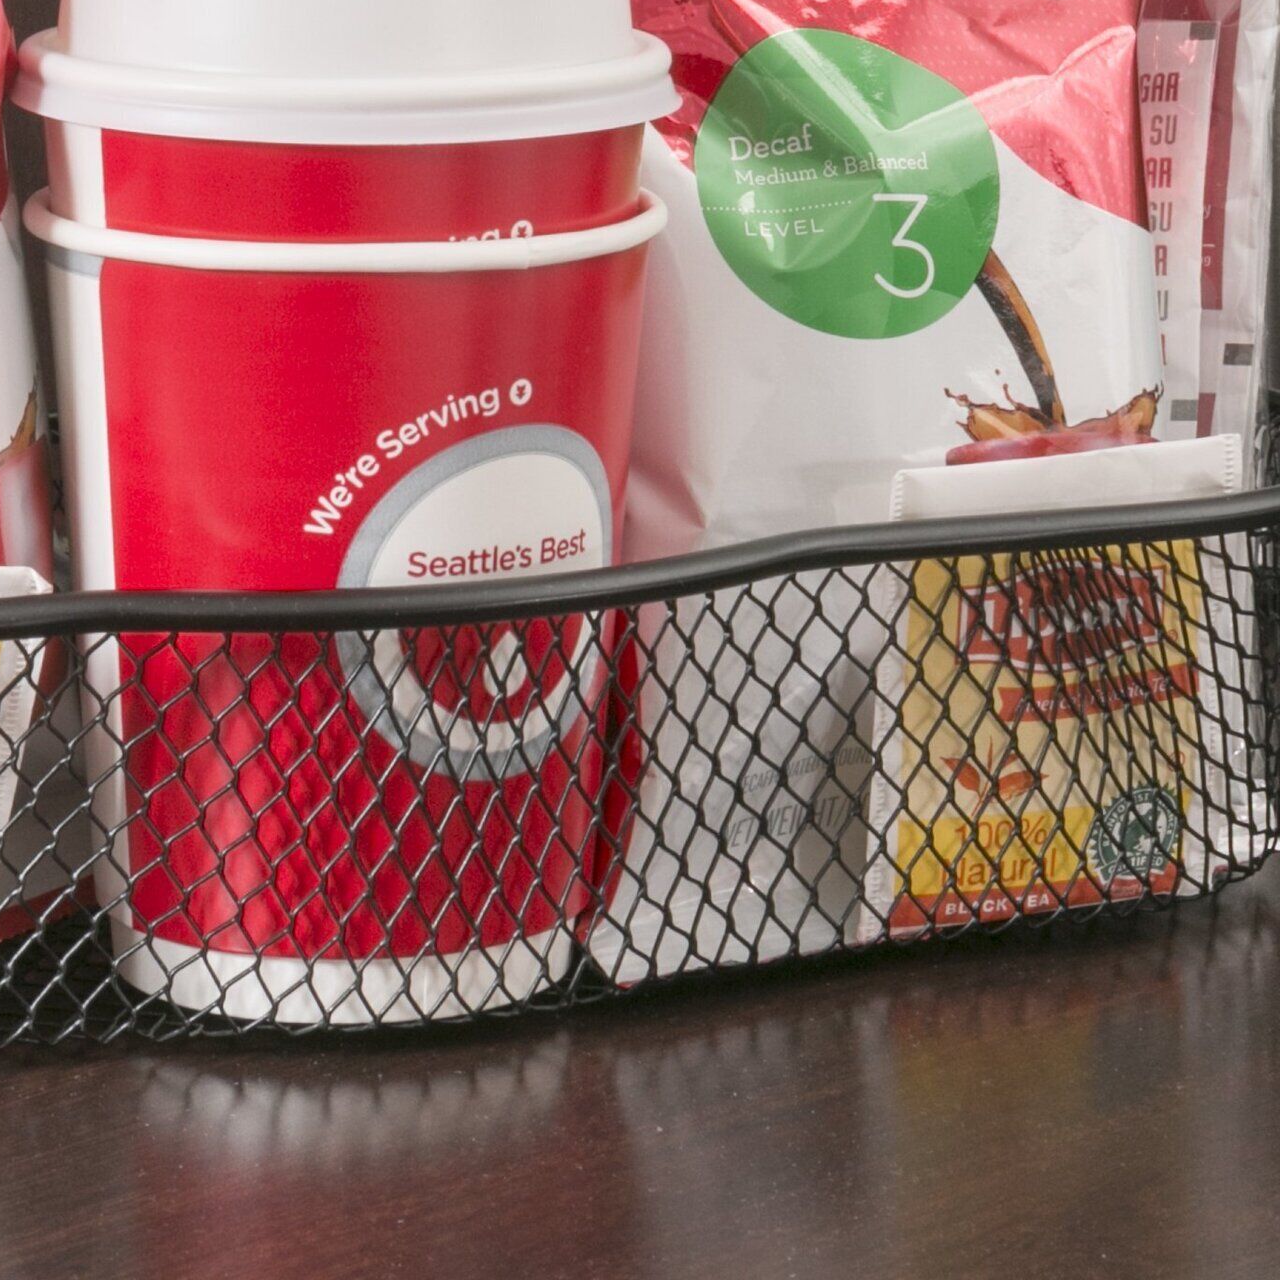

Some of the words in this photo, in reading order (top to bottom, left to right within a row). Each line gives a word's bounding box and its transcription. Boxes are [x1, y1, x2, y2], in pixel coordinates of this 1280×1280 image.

[730, 123, 812, 161] Decaf
[735, 166, 818, 187] Medium
[823, 162, 838, 178] &
[844, 152, 929, 175] Balanced
[745, 219, 824, 238] LEVEL
[873, 193, 934, 298] 3
[303, 454, 380, 537] We're
[376, 387, 500, 459] Serving
[407, 545, 532, 578] Seattle's
[540, 528, 586, 564] Best
[942, 848, 1056, 887] Naurl
[945, 899, 1007, 916] BLCK
